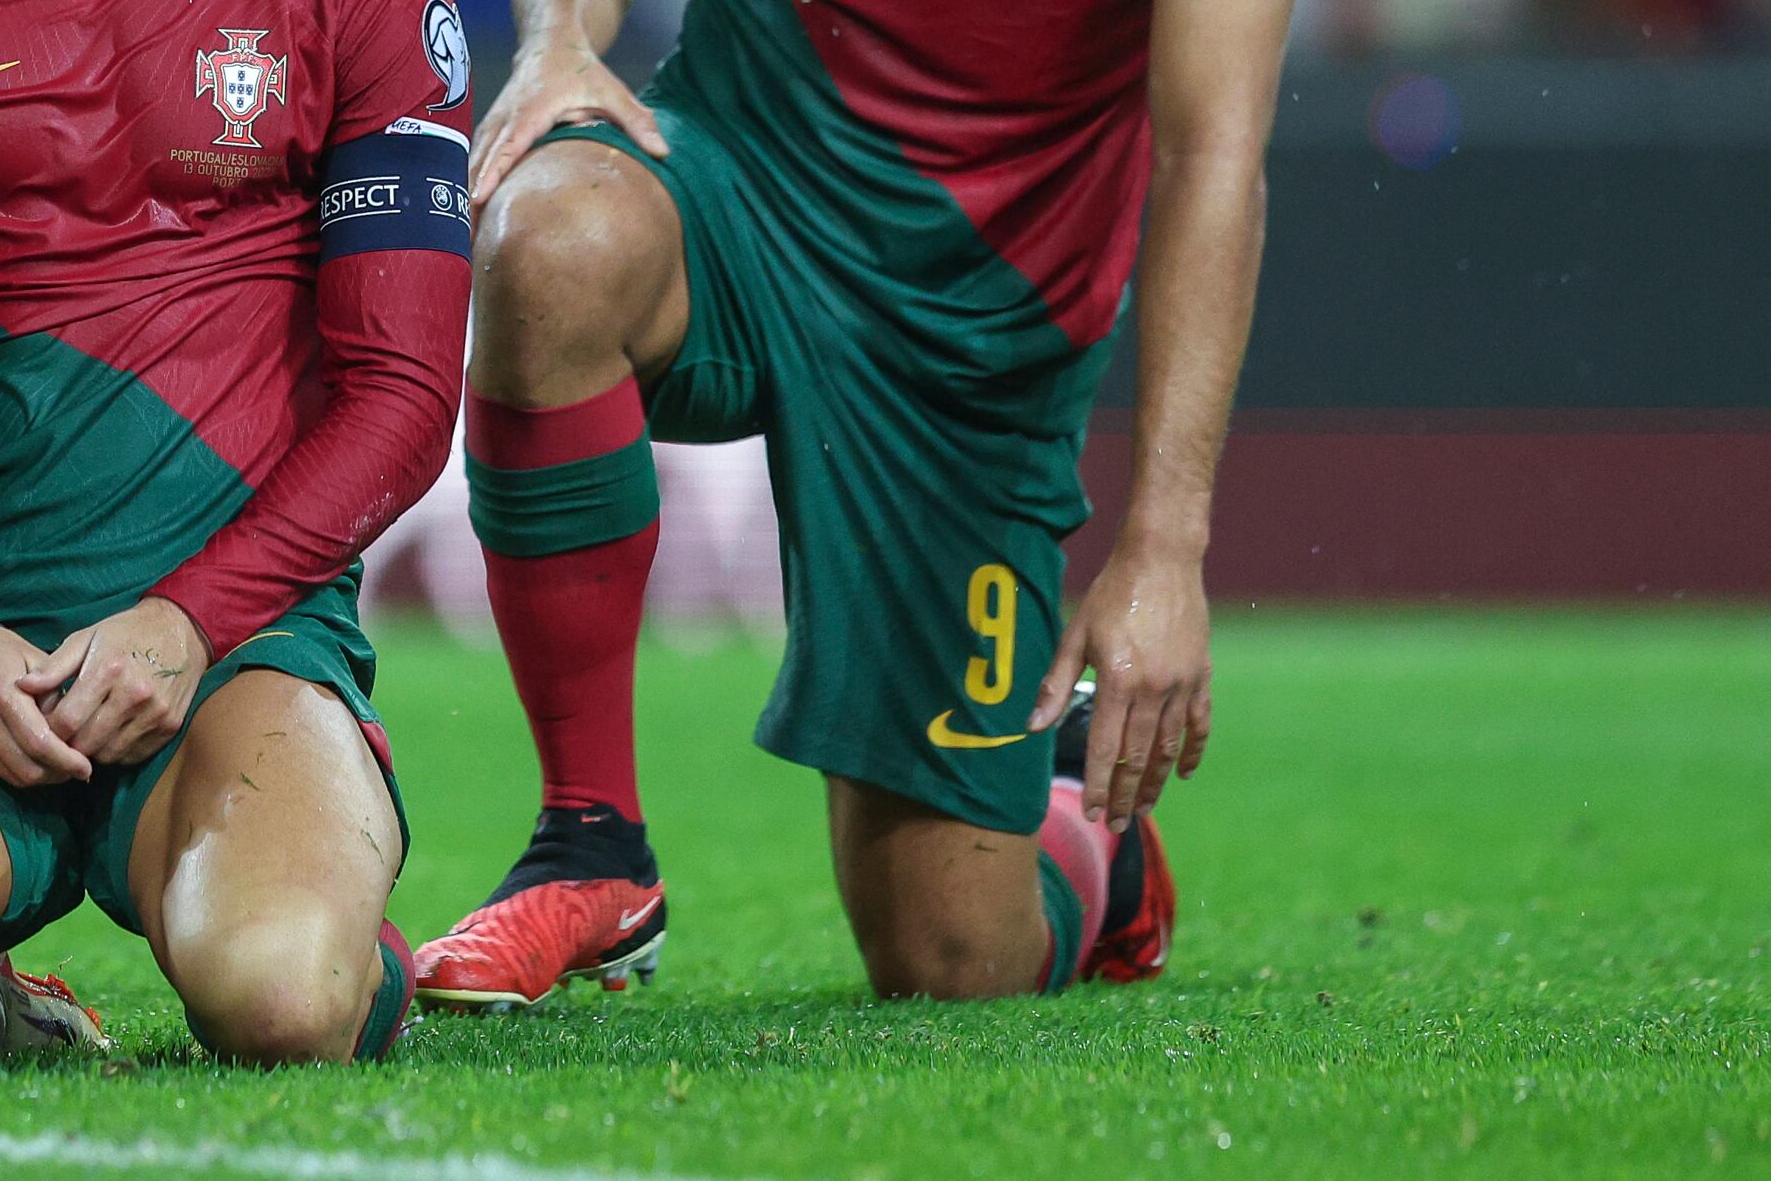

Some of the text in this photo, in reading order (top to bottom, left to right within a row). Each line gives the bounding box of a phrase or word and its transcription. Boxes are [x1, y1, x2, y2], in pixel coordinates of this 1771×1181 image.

[183, 163, 194, 175] 13
[197, 163, 249, 179] OUTUBRO
[211, 176, 244, 189] PORT
[965, 563, 1017, 705] 9
